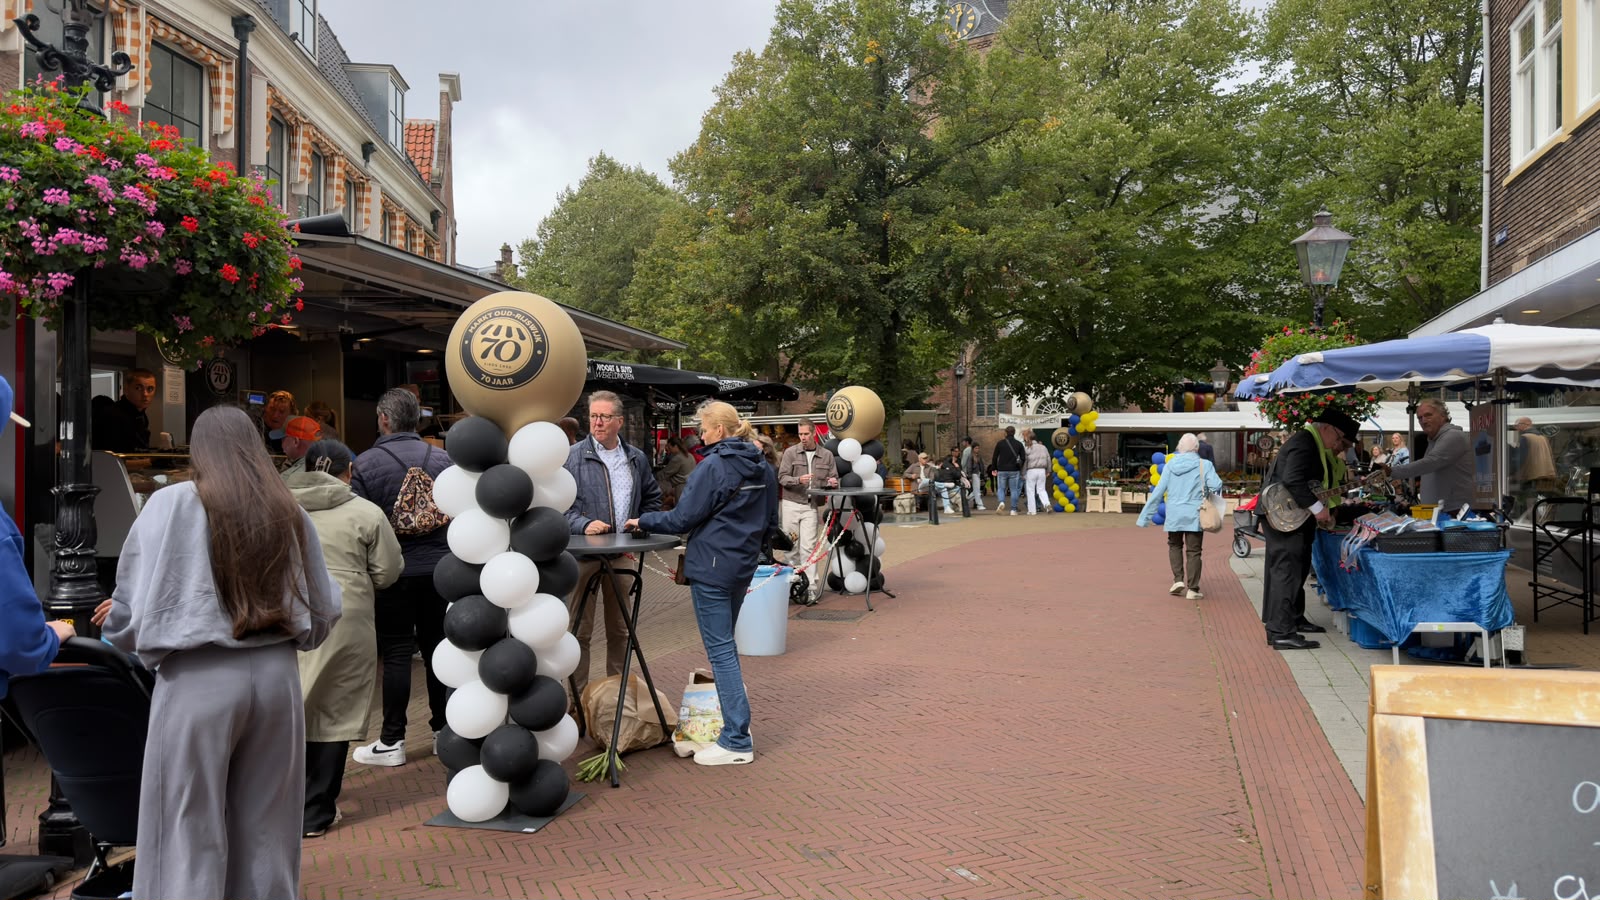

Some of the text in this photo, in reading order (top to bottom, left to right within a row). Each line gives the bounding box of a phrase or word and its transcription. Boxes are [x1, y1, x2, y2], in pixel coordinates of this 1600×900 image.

[468, 310, 543, 343] MARKT OUD-RIJSWIJK
[480, 338, 522, 362] 70
[480, 373, 514, 386] 70 JAAR
[829, 409, 844, 420] 70
